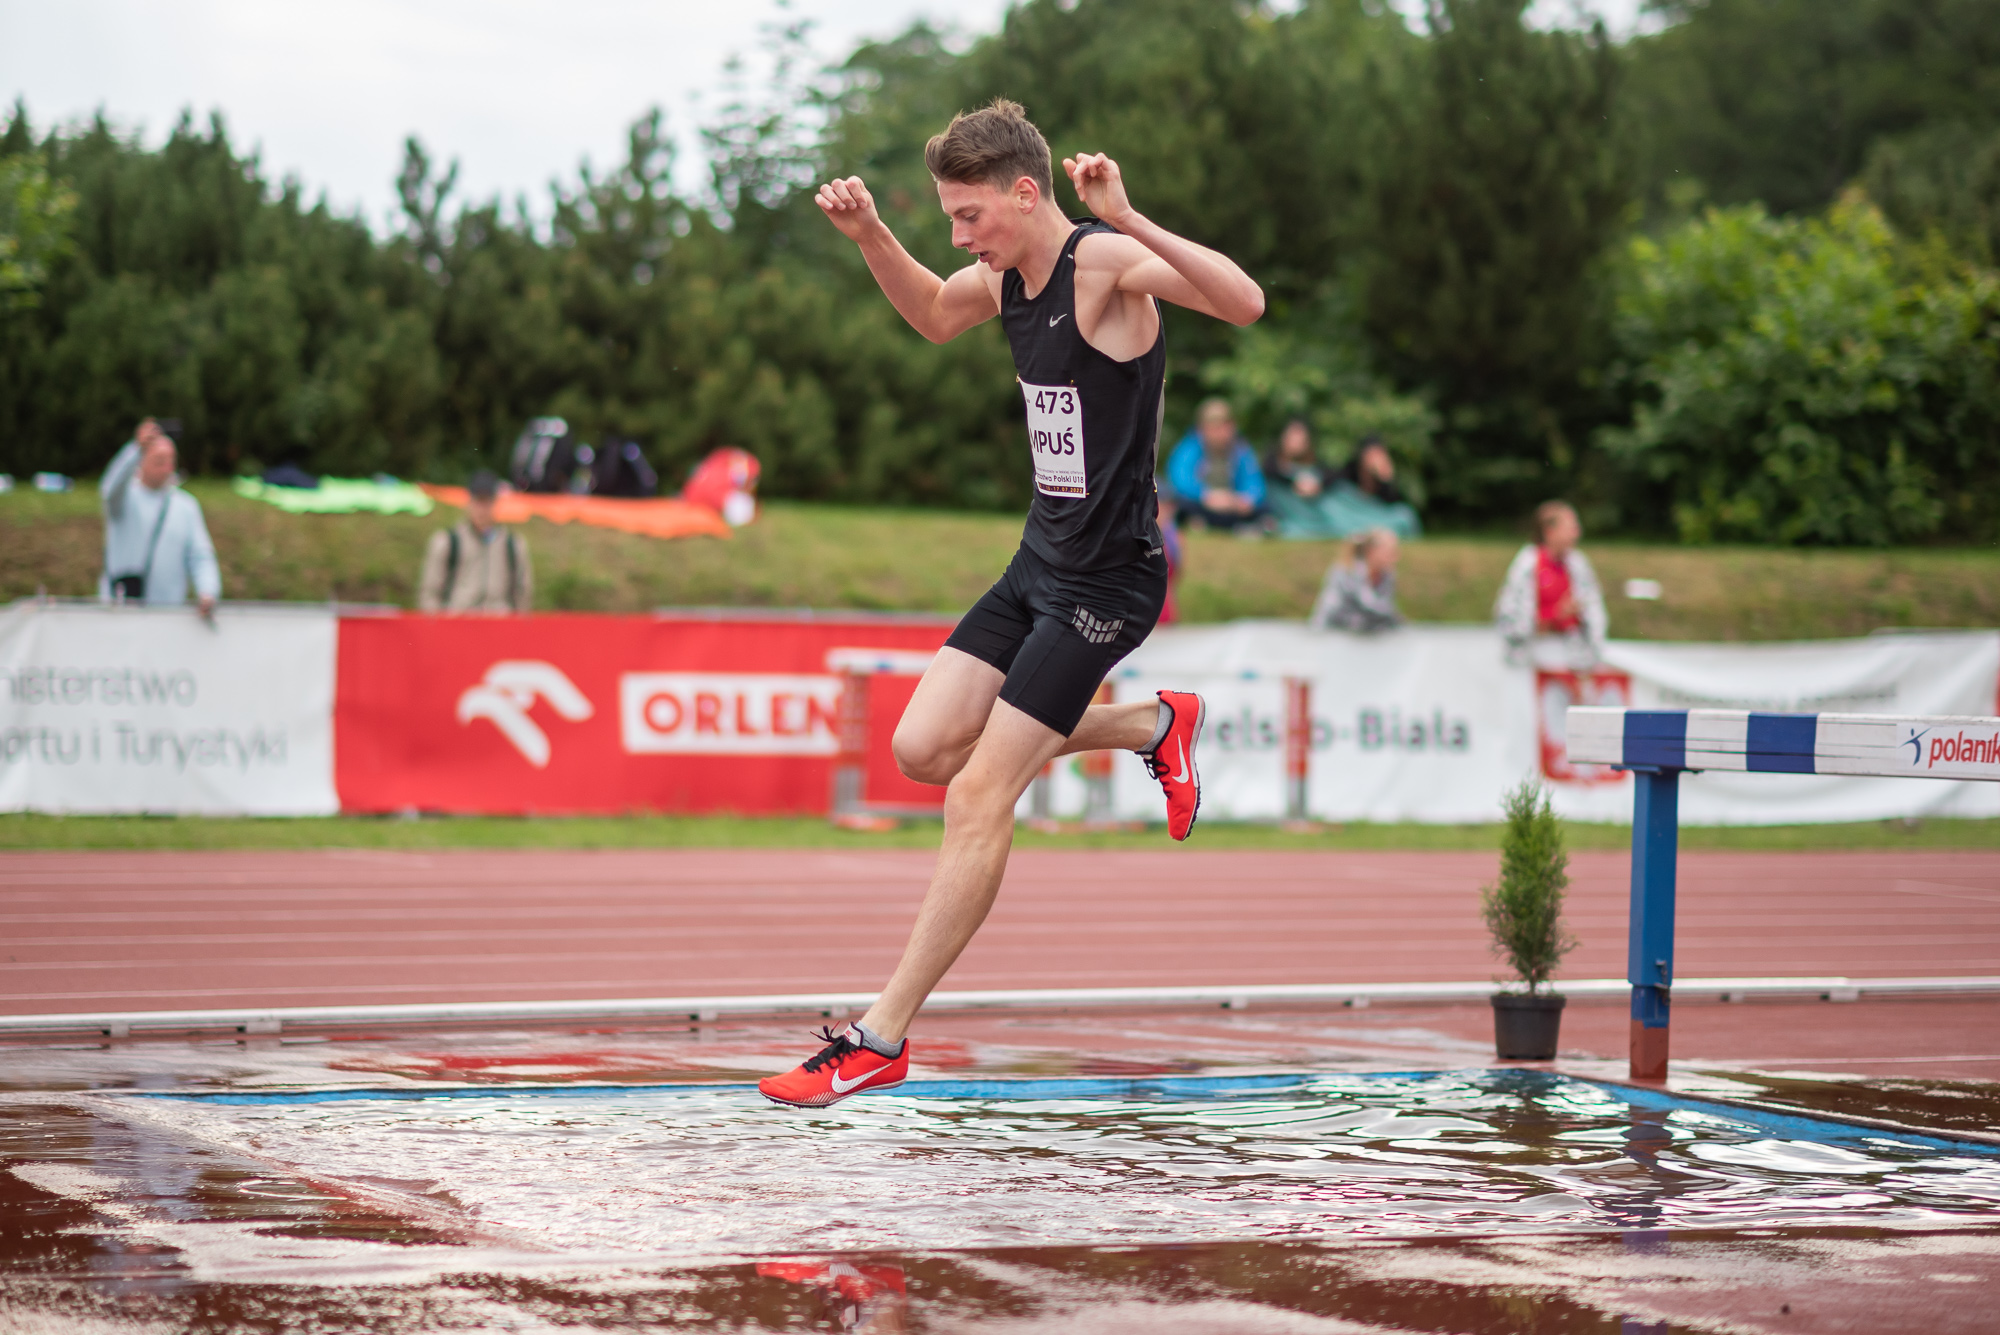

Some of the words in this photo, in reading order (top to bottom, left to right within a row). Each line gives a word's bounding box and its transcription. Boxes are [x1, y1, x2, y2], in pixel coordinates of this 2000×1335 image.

[1035, 391, 1075, 415] 473
[1053, 475, 1072, 483] Polski
[1072, 476, 1084, 484] U18
[643, 691, 840, 736] ORLEN
[91, 718, 101, 764] i
[112, 719, 288, 775] Turystyki
